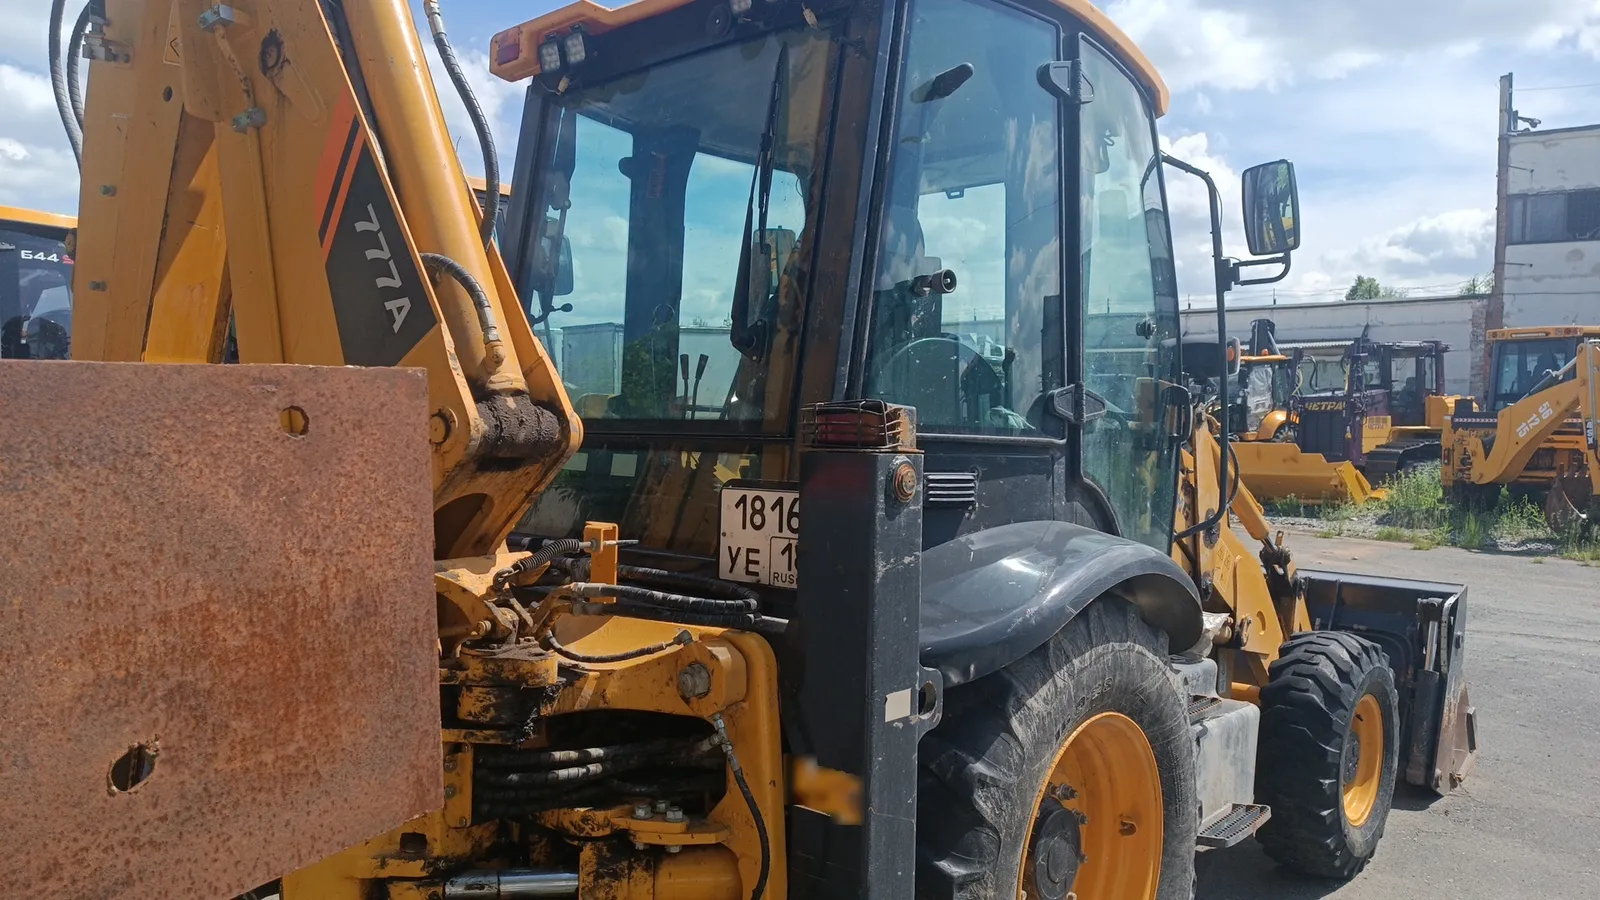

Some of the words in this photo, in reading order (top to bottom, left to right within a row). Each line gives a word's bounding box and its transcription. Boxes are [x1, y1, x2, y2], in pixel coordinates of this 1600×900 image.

[354, 203, 412, 334] 777A
[734, 493, 799, 534] 1816
[780, 542, 798, 572] 1
[772, 571, 795, 585] RUS
